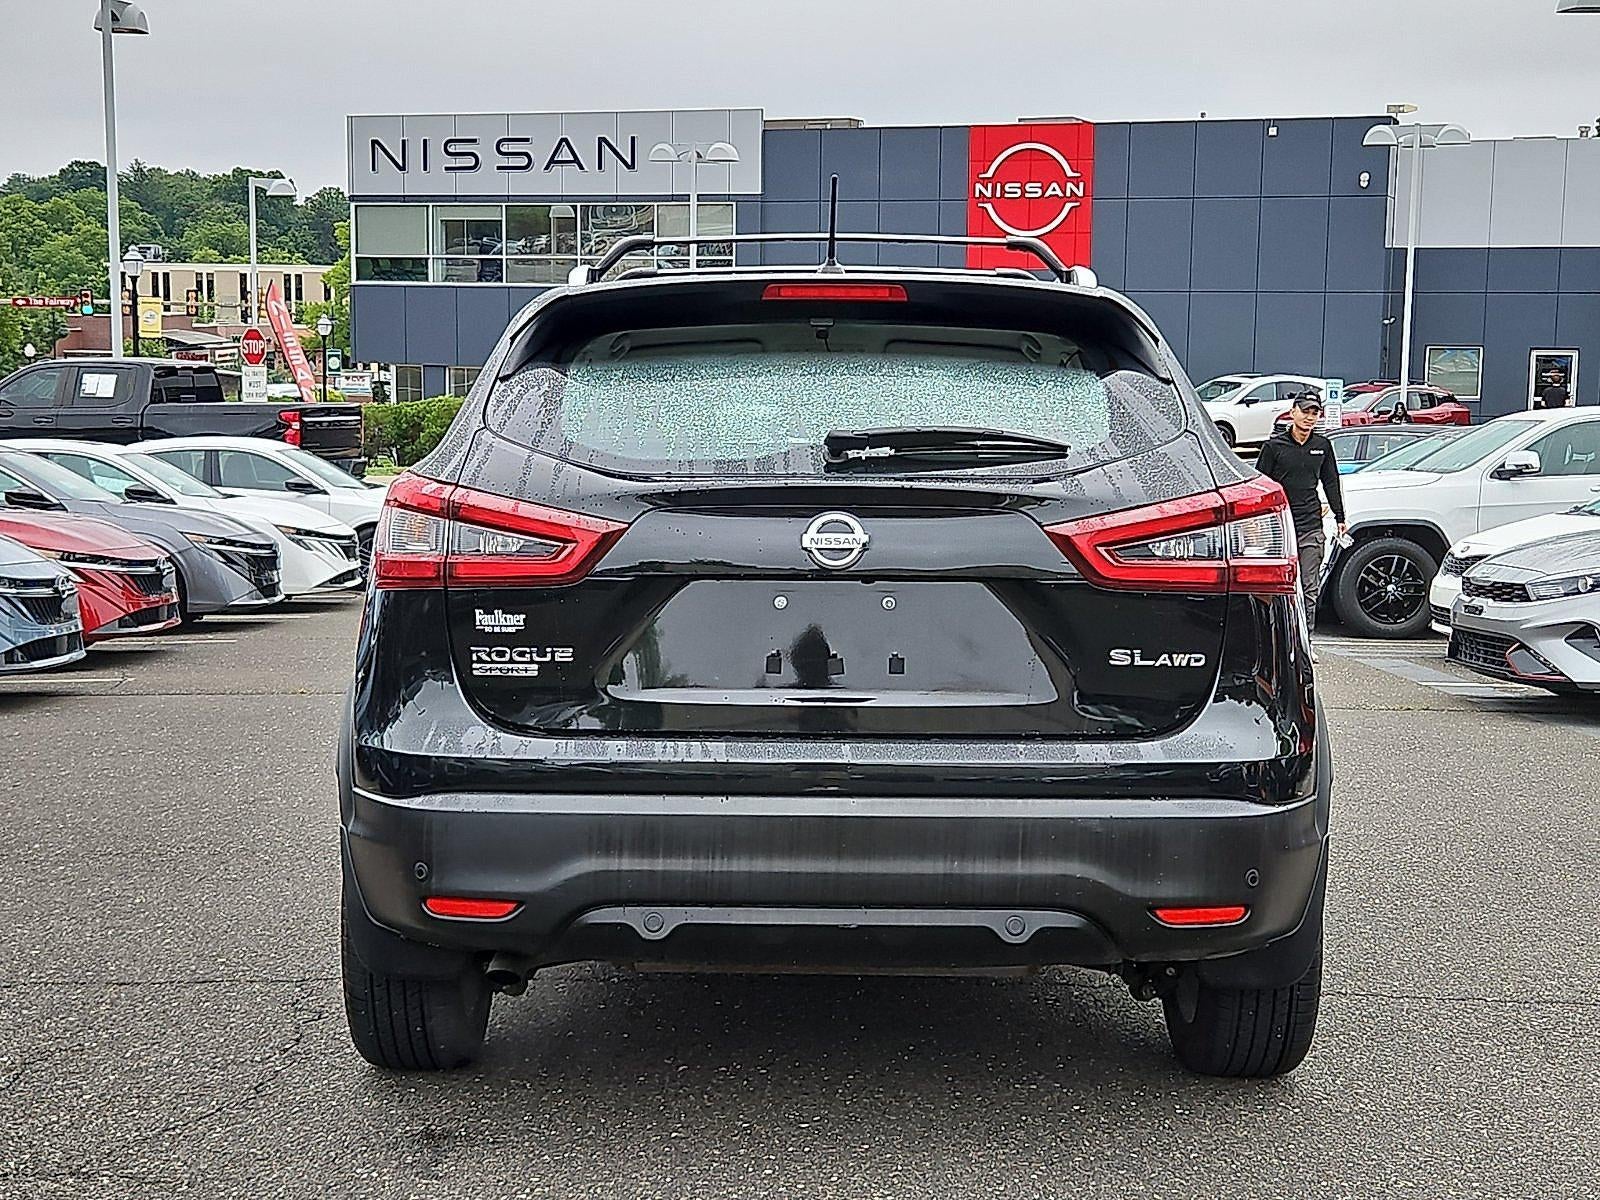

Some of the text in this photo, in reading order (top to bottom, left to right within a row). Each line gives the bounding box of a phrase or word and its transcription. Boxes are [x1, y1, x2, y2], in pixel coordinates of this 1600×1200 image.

[370, 135, 638, 173] NISSAN
[974, 181, 1085, 198] NISSAN
[242, 339, 265, 355] STOP
[809, 537, 862, 546] NISSAN
[475, 608, 526, 626] Faulkner
[470, 646, 575, 662] ROGUE
[478, 664, 530, 674] SPORT
